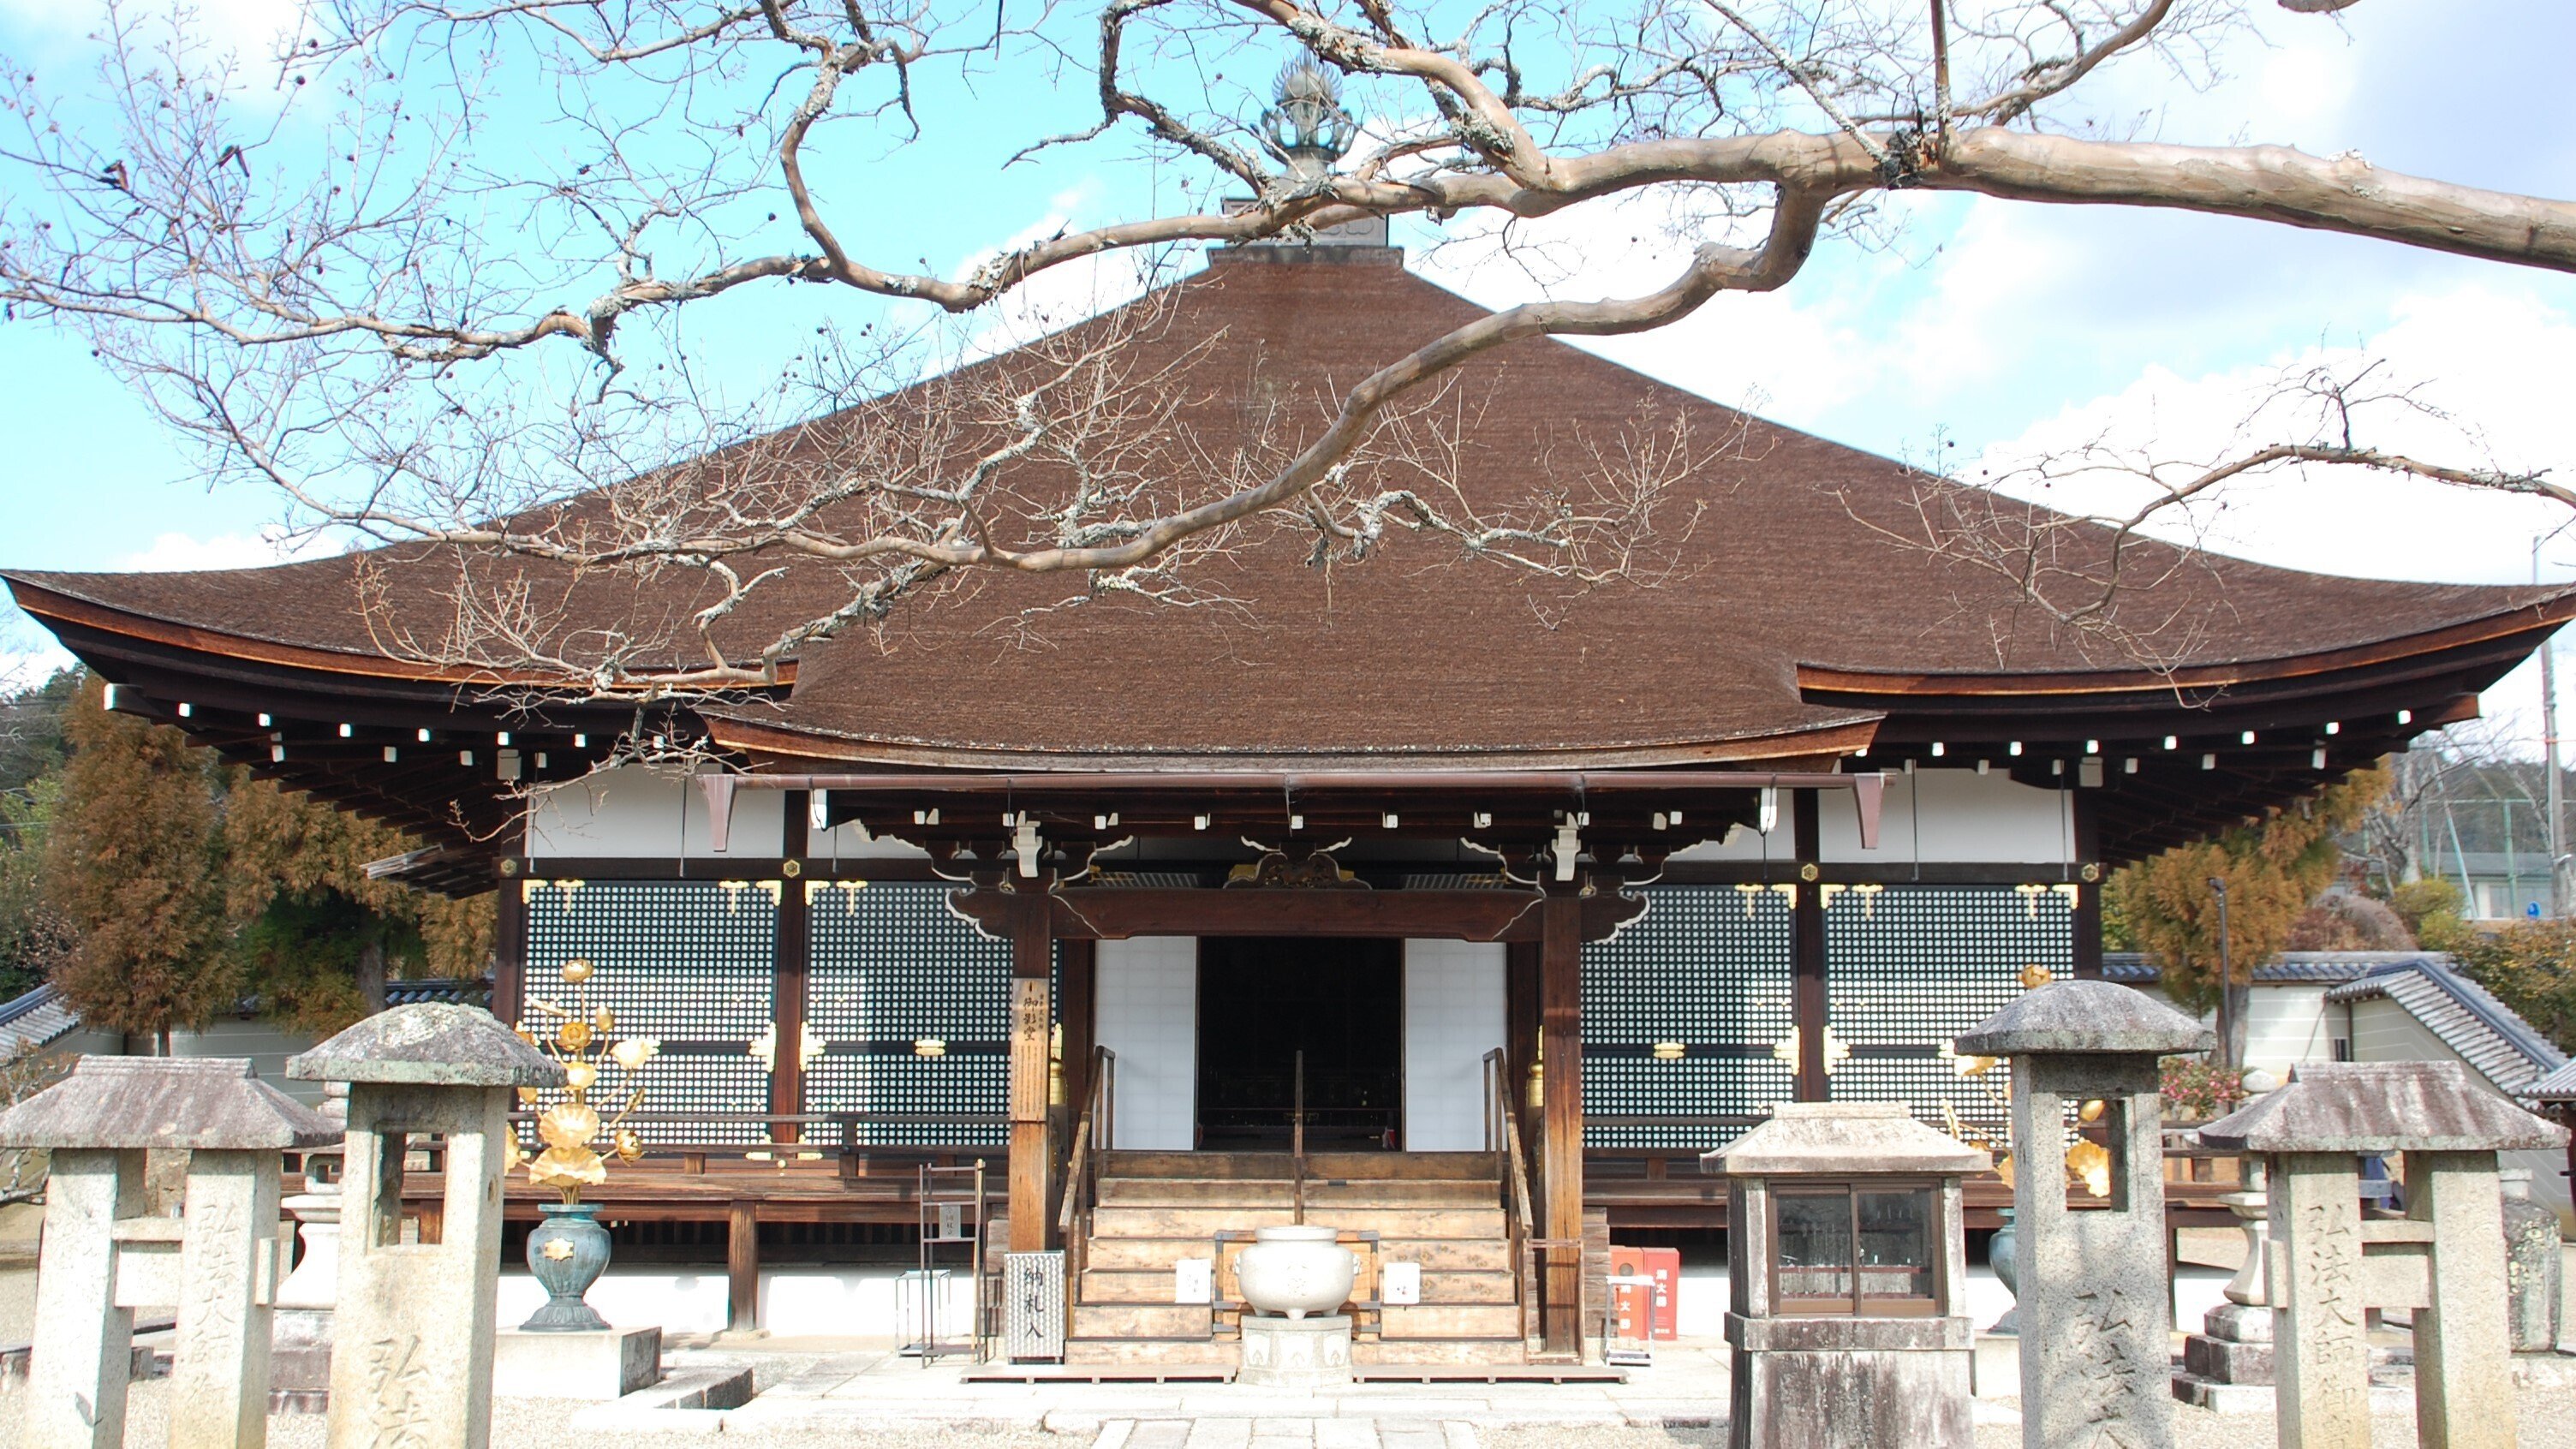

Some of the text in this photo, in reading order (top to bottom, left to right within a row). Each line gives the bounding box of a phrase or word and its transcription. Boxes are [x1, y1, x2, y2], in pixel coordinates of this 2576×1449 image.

[1023, 997, 1038, 1041] 御影堂
[1024, 1267, 1044, 1338] 納札入
